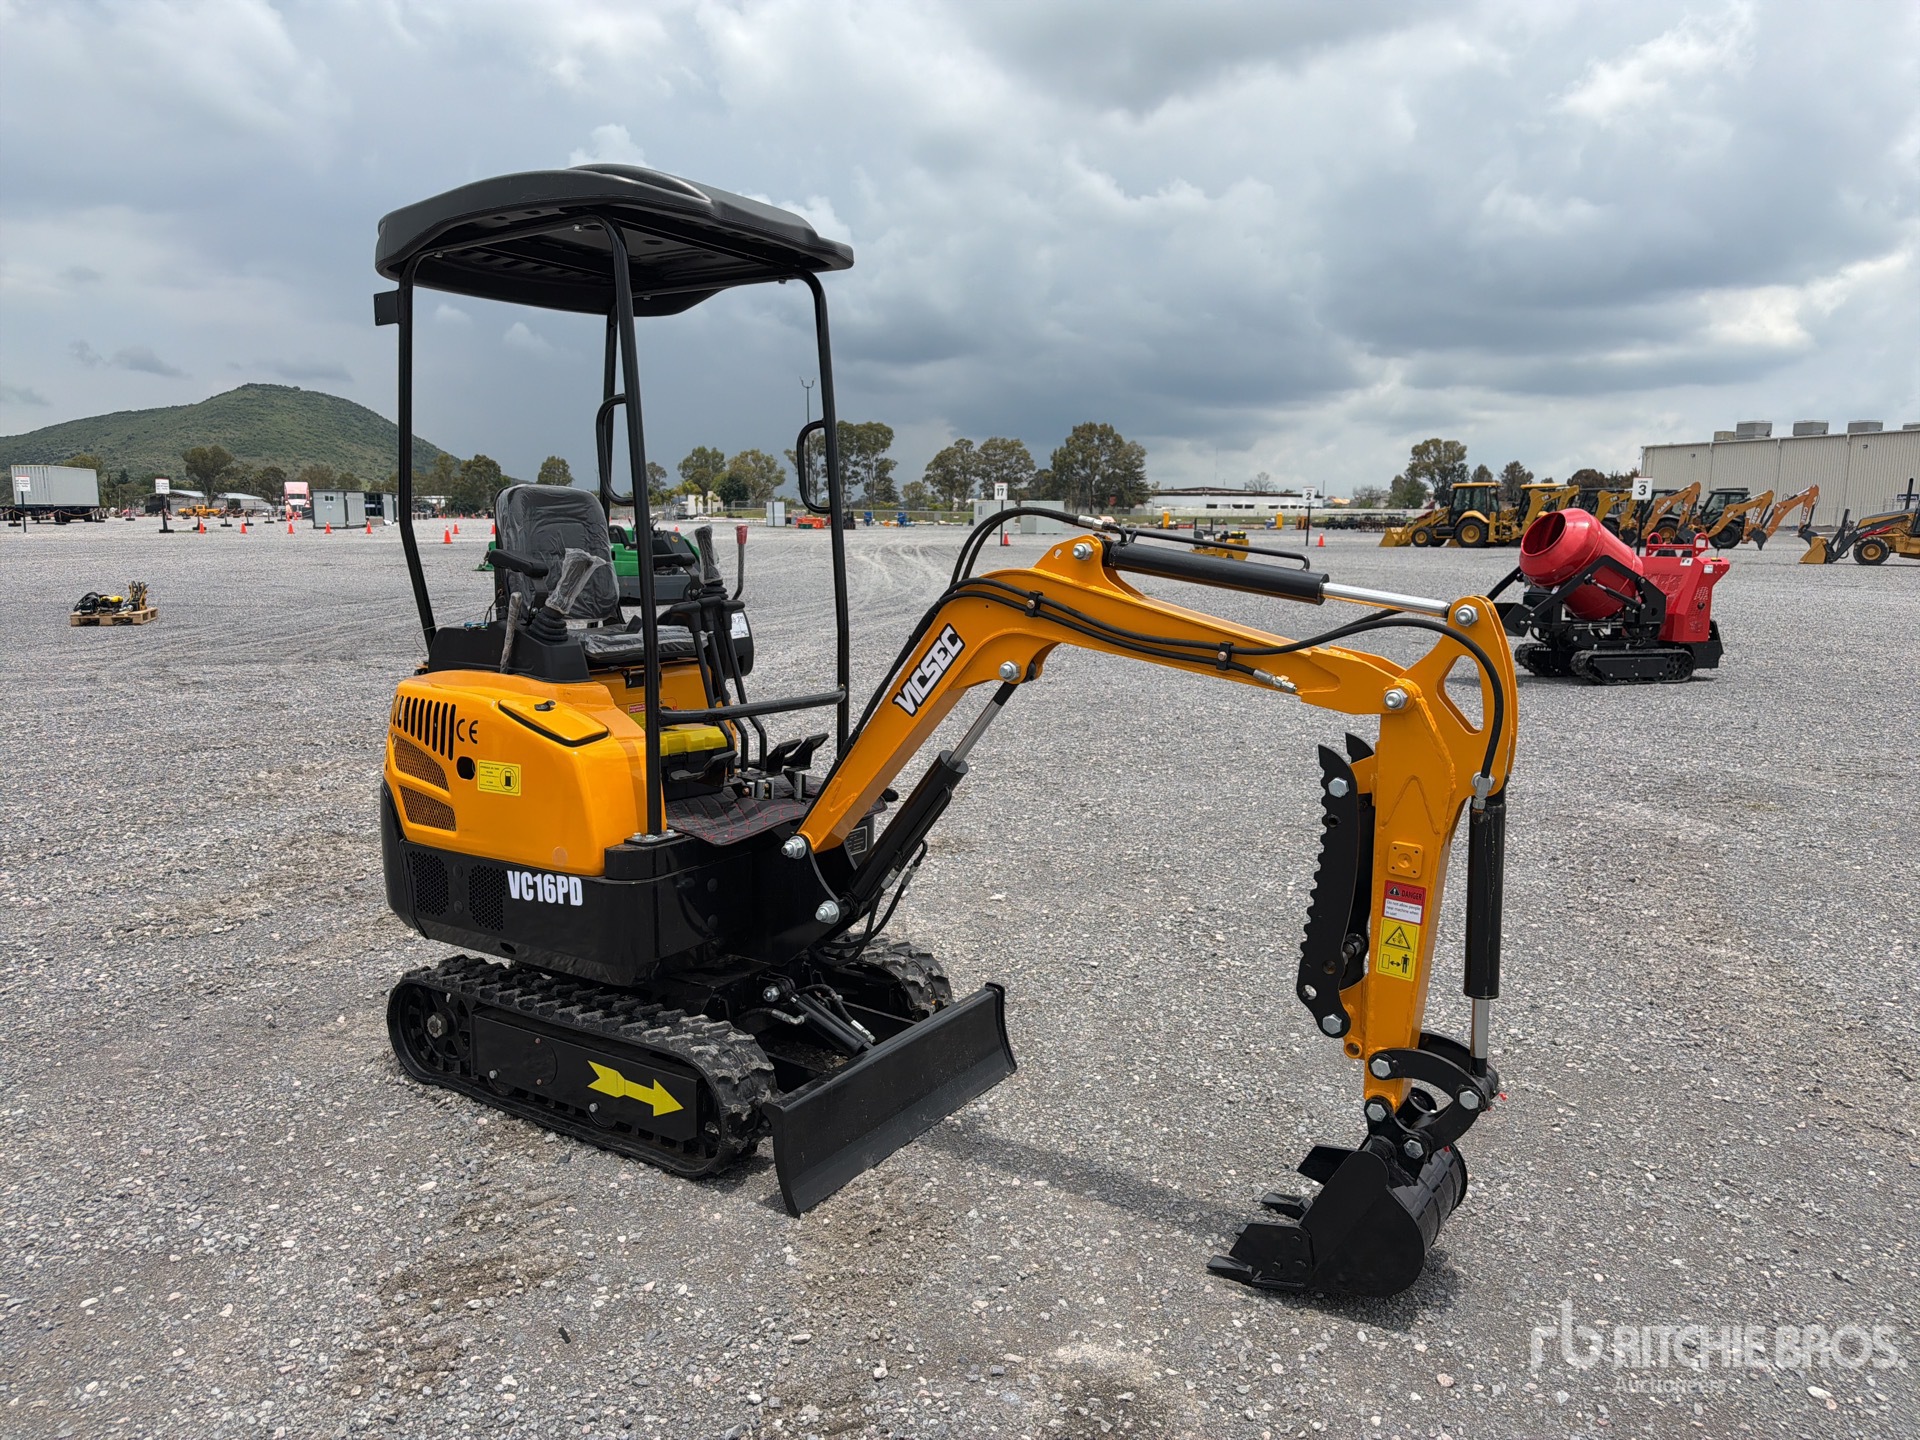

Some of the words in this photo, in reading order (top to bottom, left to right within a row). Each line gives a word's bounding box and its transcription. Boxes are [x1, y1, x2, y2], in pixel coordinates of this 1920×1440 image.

[996, 487, 1004, 496] 17
[1638, 485, 1647, 496] 3
[1305, 492, 1312, 501] 2
[893, 625, 964, 716] VICSEC
[456, 718, 479, 745] CE
[506, 870, 583, 906] VC16PD
[1401, 890, 1422, 900] DANGER
